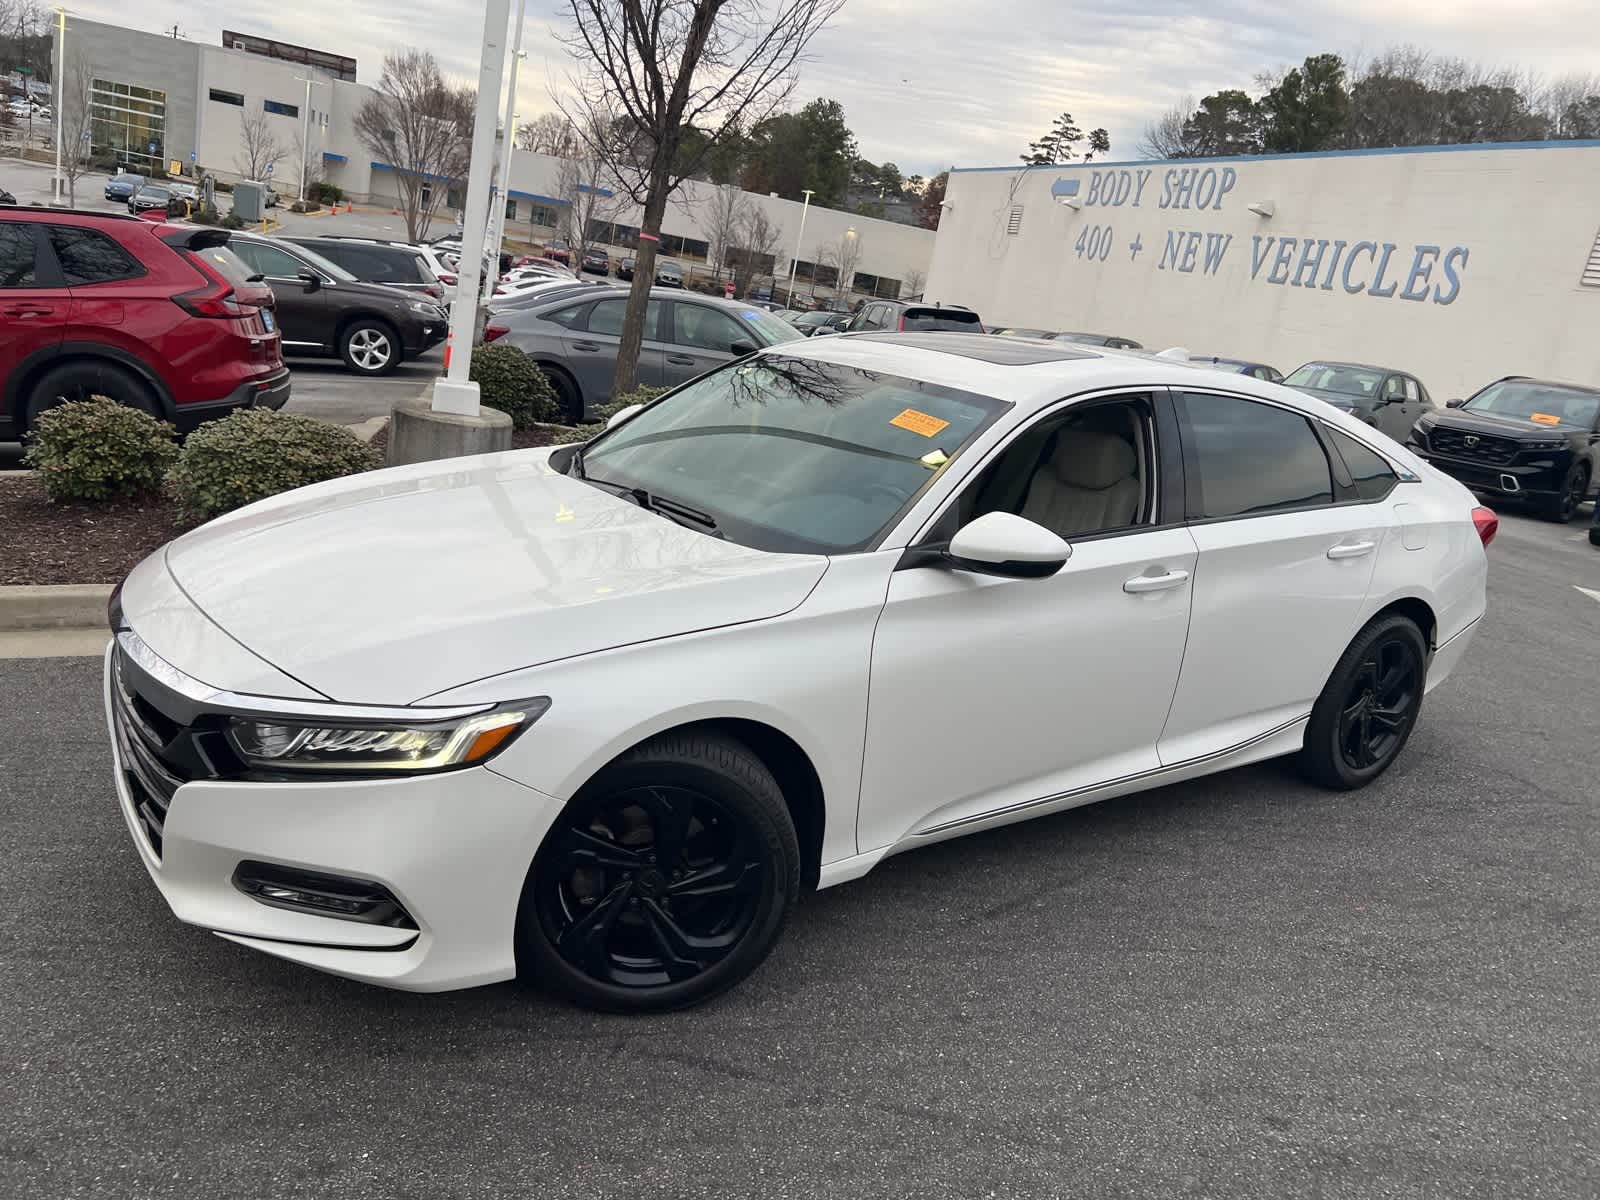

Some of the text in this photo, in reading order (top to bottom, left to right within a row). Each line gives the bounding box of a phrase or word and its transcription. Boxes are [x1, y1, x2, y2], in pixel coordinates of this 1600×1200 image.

[1085, 167, 1237, 210] BODY SHOP
[1075, 223, 1470, 306] 400 + NEW VEHICLES
